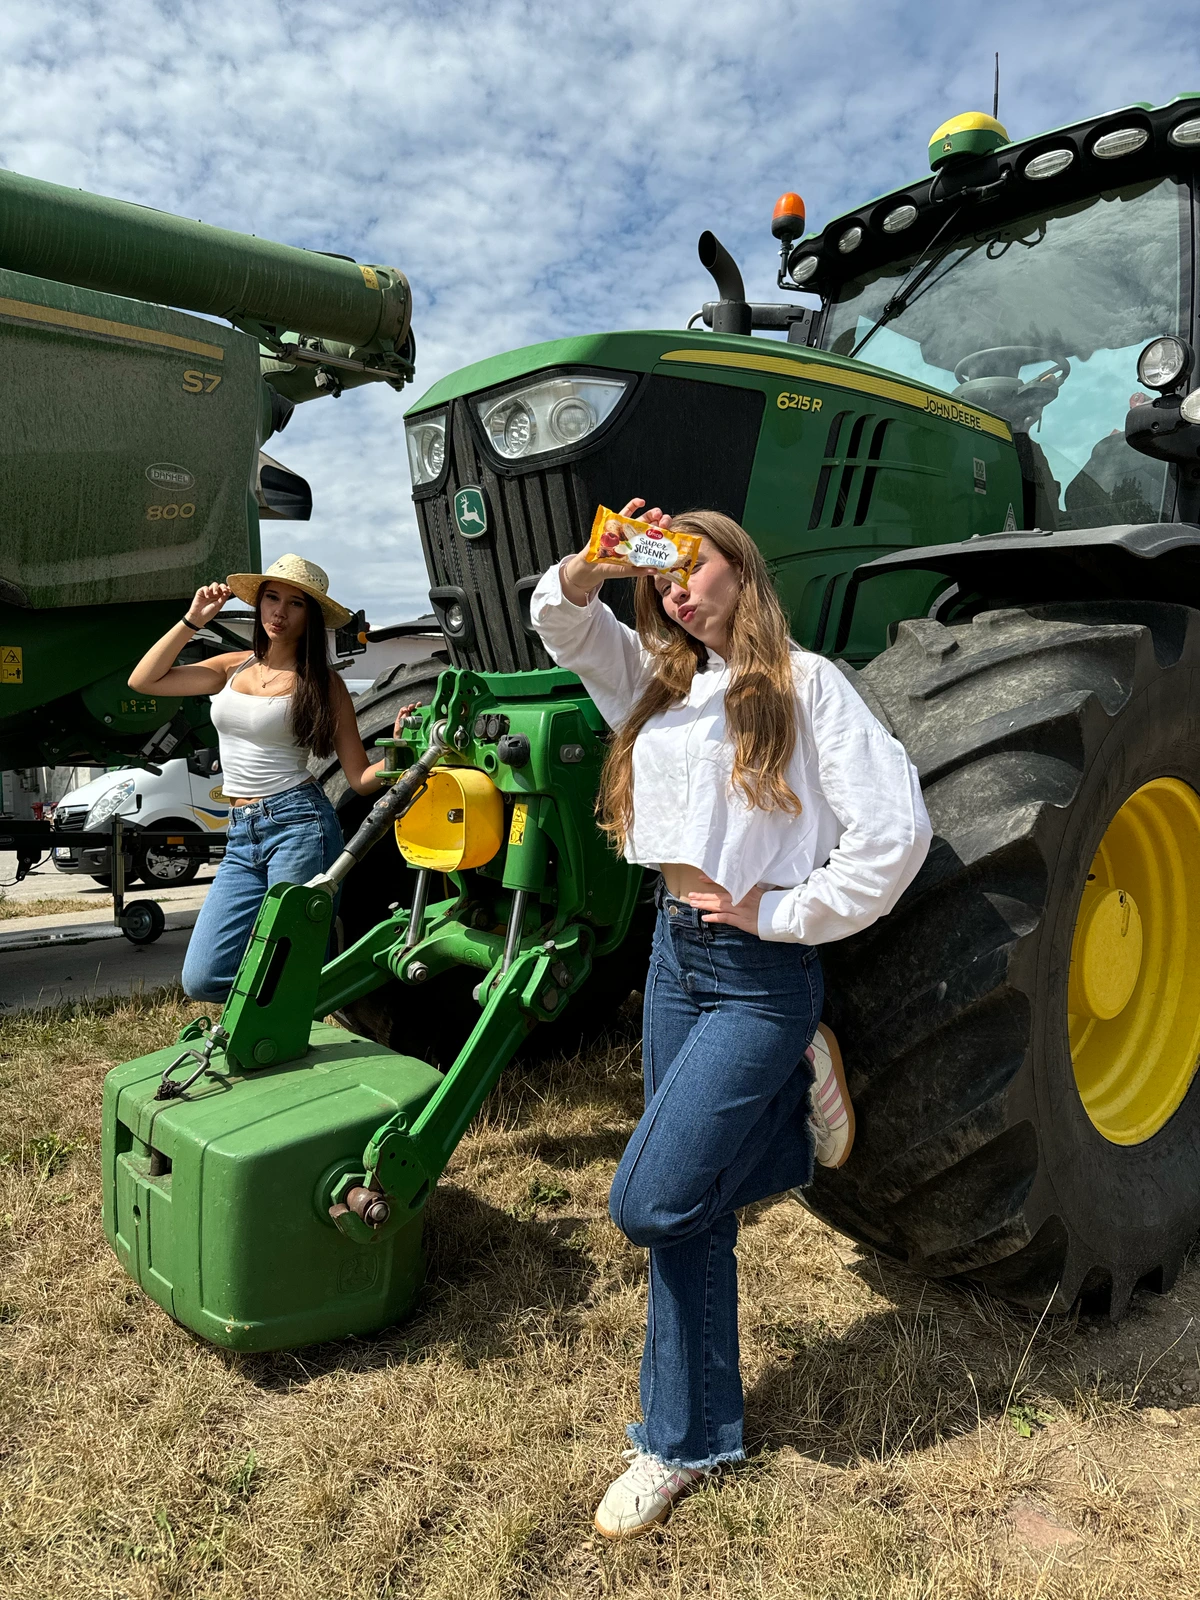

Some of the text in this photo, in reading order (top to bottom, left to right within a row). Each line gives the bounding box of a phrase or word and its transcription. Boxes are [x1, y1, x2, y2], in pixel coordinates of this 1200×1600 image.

[182, 369, 222, 393] S7
[923, 395, 983, 430] JOHN DEERE
[146, 502, 196, 521] 800
[634, 544, 670, 560] SUŠENKY
